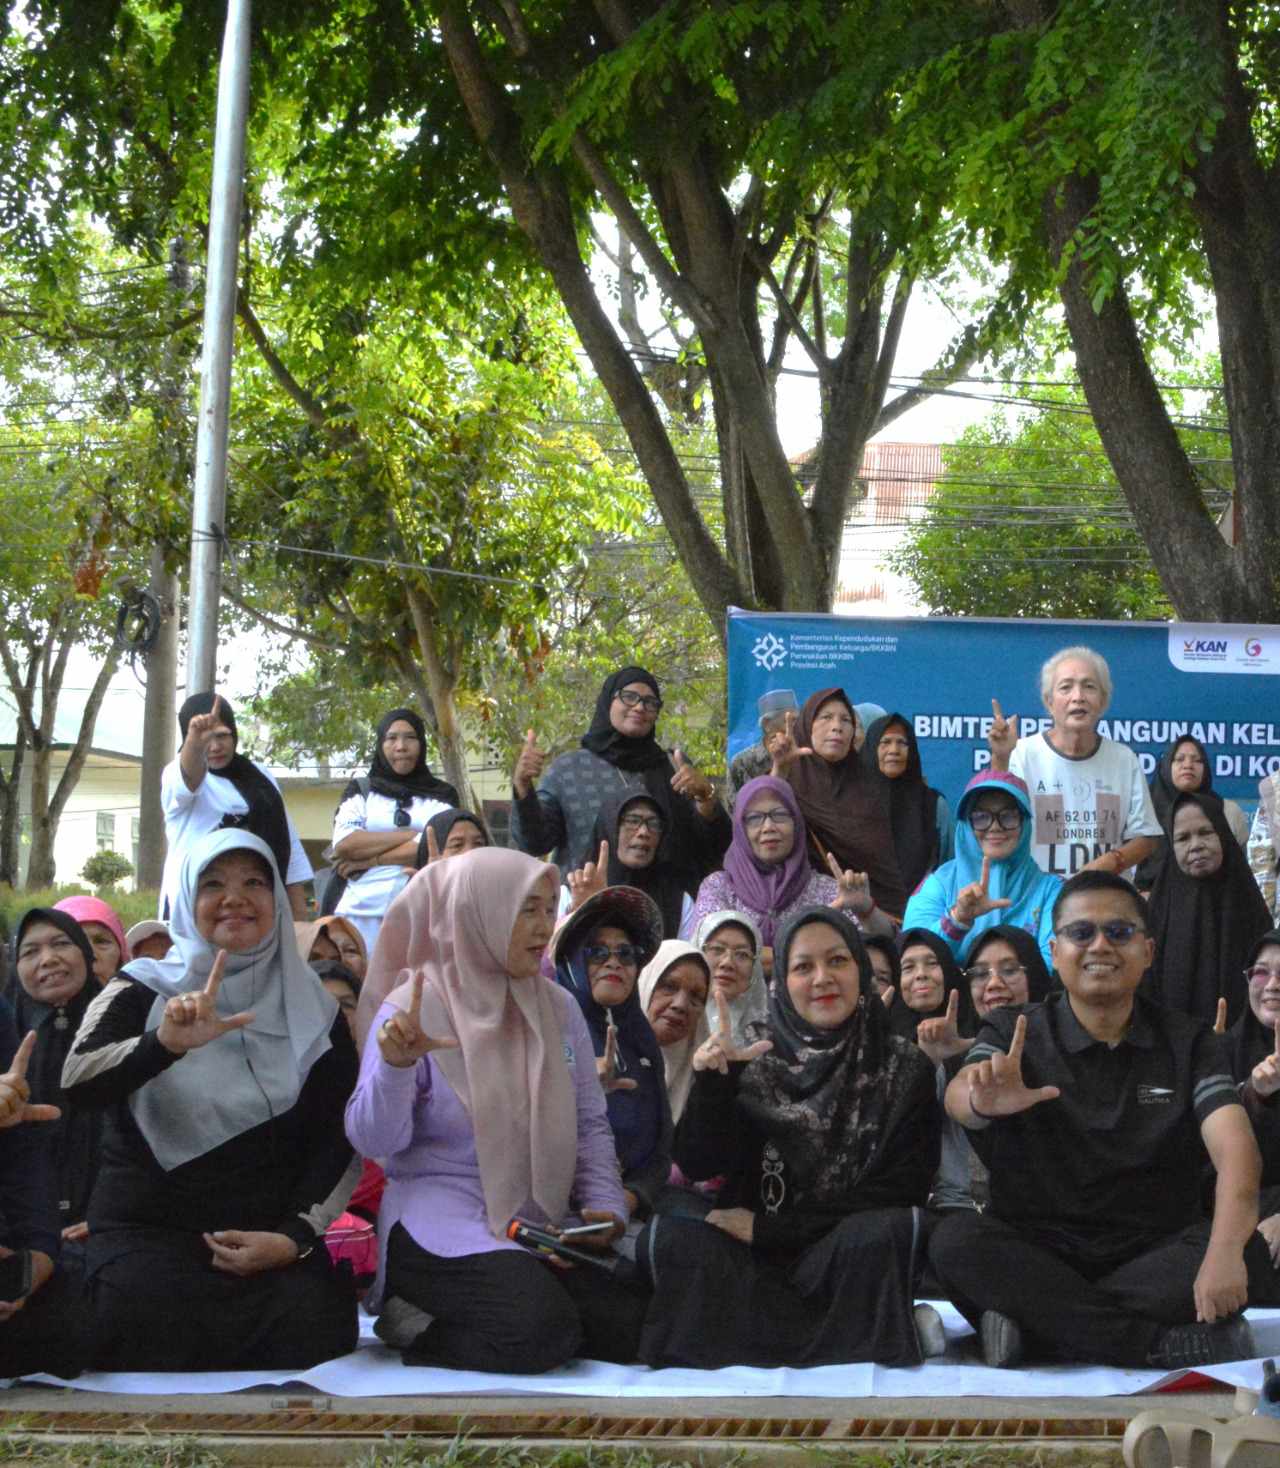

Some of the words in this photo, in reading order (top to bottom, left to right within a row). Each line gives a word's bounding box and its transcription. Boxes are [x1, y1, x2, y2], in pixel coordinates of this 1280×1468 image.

[914, 715, 1011, 739] BIMTE
[1021, 718, 1225, 744] PEANGUNAN
[1216, 755, 1242, 776] DI
[1065, 810, 1079, 822] 62
